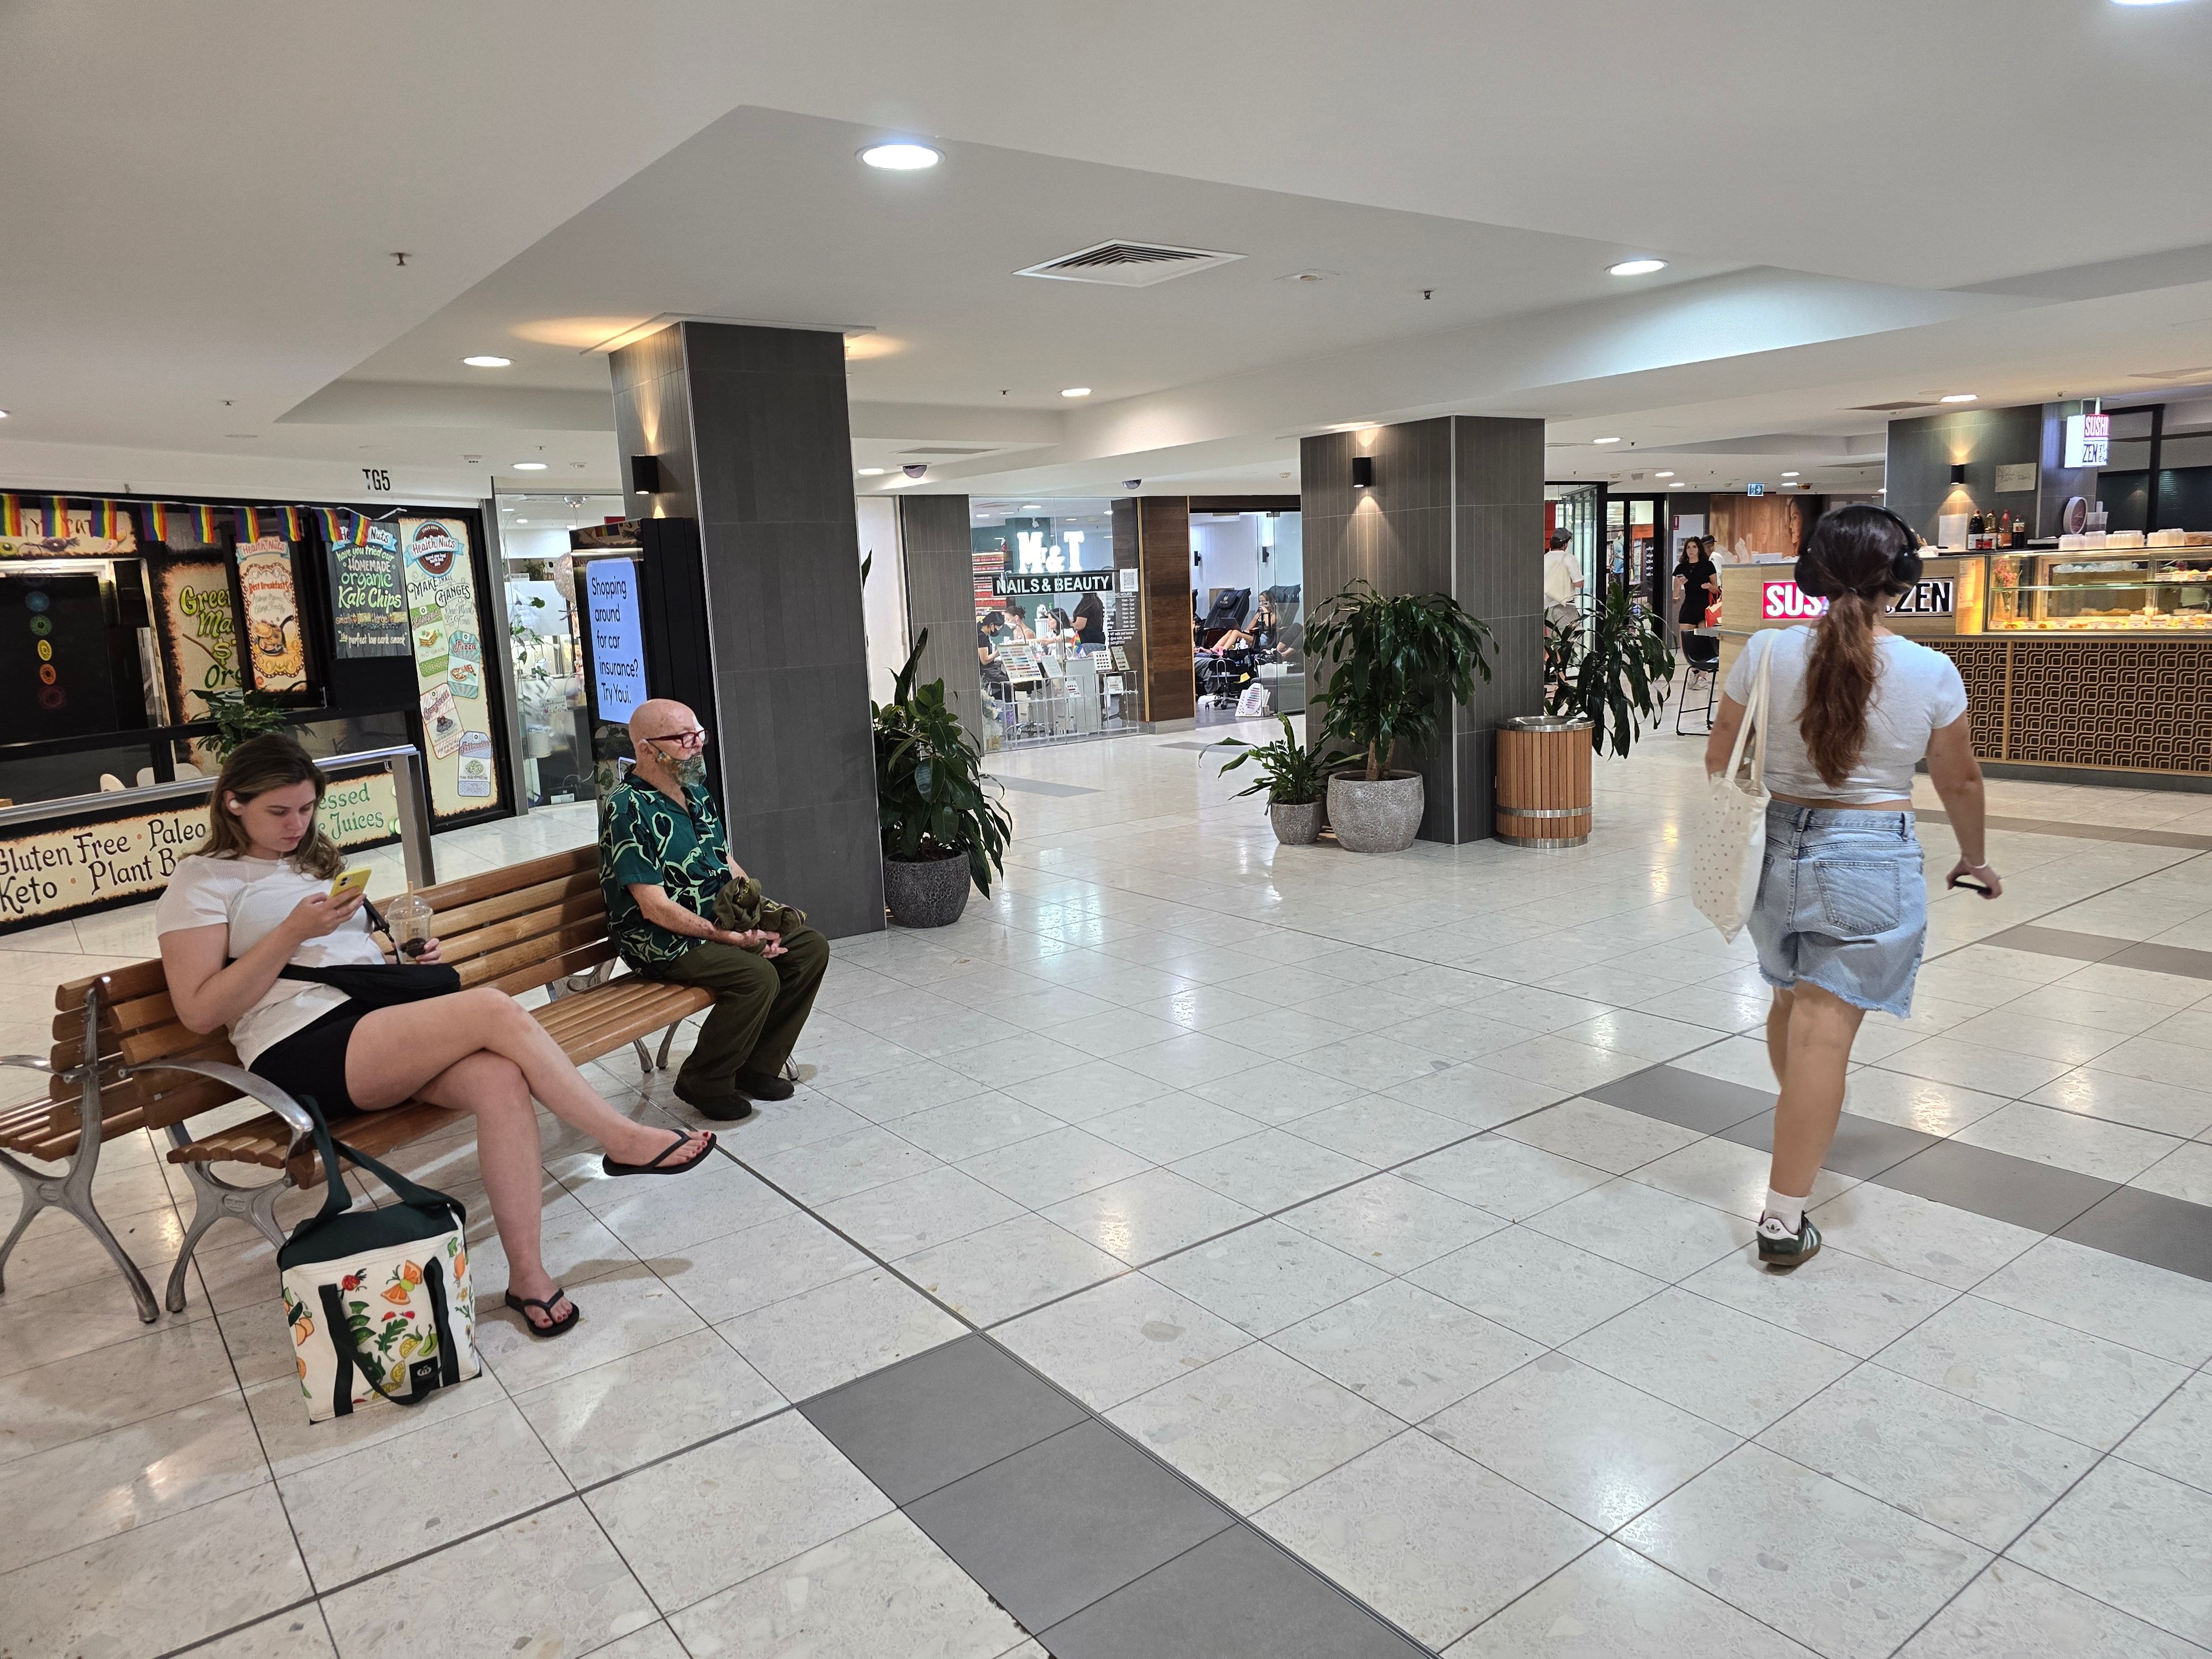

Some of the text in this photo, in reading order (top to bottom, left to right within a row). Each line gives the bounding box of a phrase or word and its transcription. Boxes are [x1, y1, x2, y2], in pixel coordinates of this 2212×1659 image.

[2085, 416, 2109, 436] SUSHI
[2083, 444, 2098, 463] ZEN
[362, 469, 390, 491] TG5
[371, 528, 389, 542] Nuts
[242, 540, 284, 554] Health Nuts
[336, 545, 395, 562] have you tried our
[412, 536, 455, 555] Health Nuts
[348, 558, 390, 572] HOMEMADE
[249, 583, 260, 594] Best
[341, 572, 393, 590] organic
[408, 575, 453, 600] MAKE SMALL
[592, 576, 627, 599] Shopping
[997, 576, 1109, 594] NAILS & BEAUTY
[338, 586, 401, 614] Kale Chips
[435, 585, 471, 608] CHANGES
[1766, 582, 1953, 617] SUS ZEN
[445, 605, 456, 614] One
[595, 603, 620, 622] around
[348, 633, 367, 649] perfect
[453, 639, 476, 654] Pizza
[597, 630, 620, 649] for car
[599, 656, 638, 677] insurance?
[601, 682, 632, 705] Try Youi.
[318, 782, 370, 810] essed
[330, 811, 384, 840] Juices
[0, 818, 206, 875] Gluten Free Paleo
[0, 875, 58, 914] Keto
[88, 855, 153, 896] Plant
